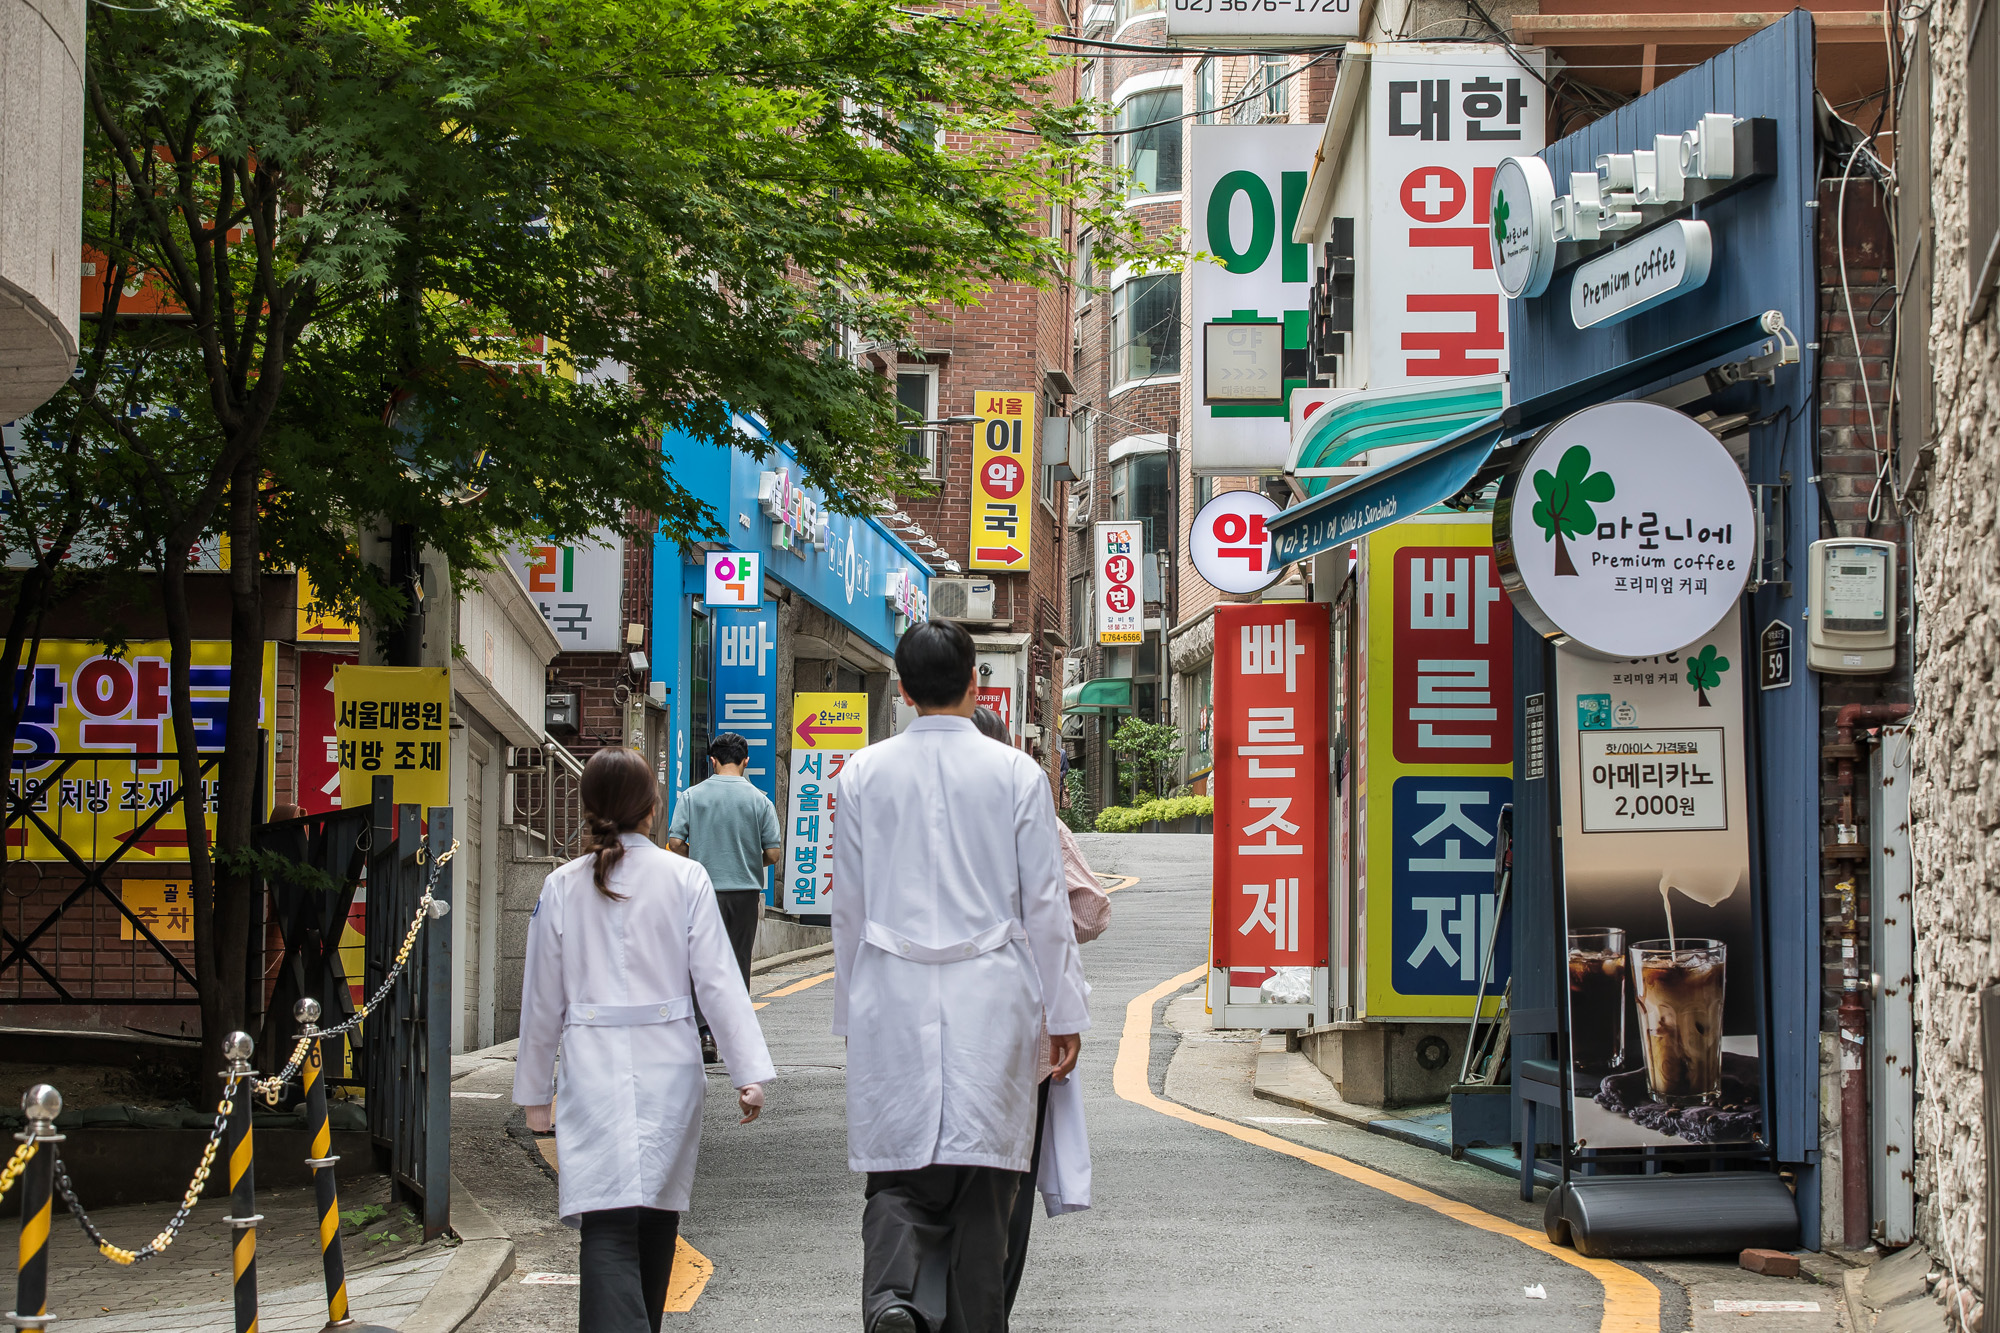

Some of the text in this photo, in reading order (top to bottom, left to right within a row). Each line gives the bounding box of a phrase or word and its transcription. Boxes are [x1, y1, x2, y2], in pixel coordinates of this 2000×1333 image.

[1388, 77, 1528, 141] 대한
[1582, 246, 1676, 308] Premium coffee
[1227, 328, 1262, 364] 약
[986, 397, 1023, 415] 서울
[1364, 495, 1397, 525] Sandwich
[1212, 513, 1269, 571] 약
[1597, 512, 1732, 550] 마로니에
[1591, 551, 1736, 571] Premium coffee
[715, 556, 752, 601] 약
[1108, 558, 1130, 611] 냉면
[1614, 576, 1708, 596] 프리미엄 커피
[1613, 673, 1678, 685] 프리미엄 커피
[1768, 652, 1784, 679] 59
[338, 700, 443, 731] 서울대병원
[819, 710, 861, 725] 온누리약국
[833, 700, 849, 709] 서울
[339, 739, 442, 771] 처방 조제
[1605, 741, 1698, 755] 핫/아이스 가격동일
[1406, 555, 1500, 984] 빠른 조제
[1592, 762, 1714, 790] 아메리카노
[58, 779, 112, 813] 처방
[119, 780, 174, 813] 조제
[1615, 795, 1695, 819] 2,000원
[792, 752, 823, 905] 서울대병원
